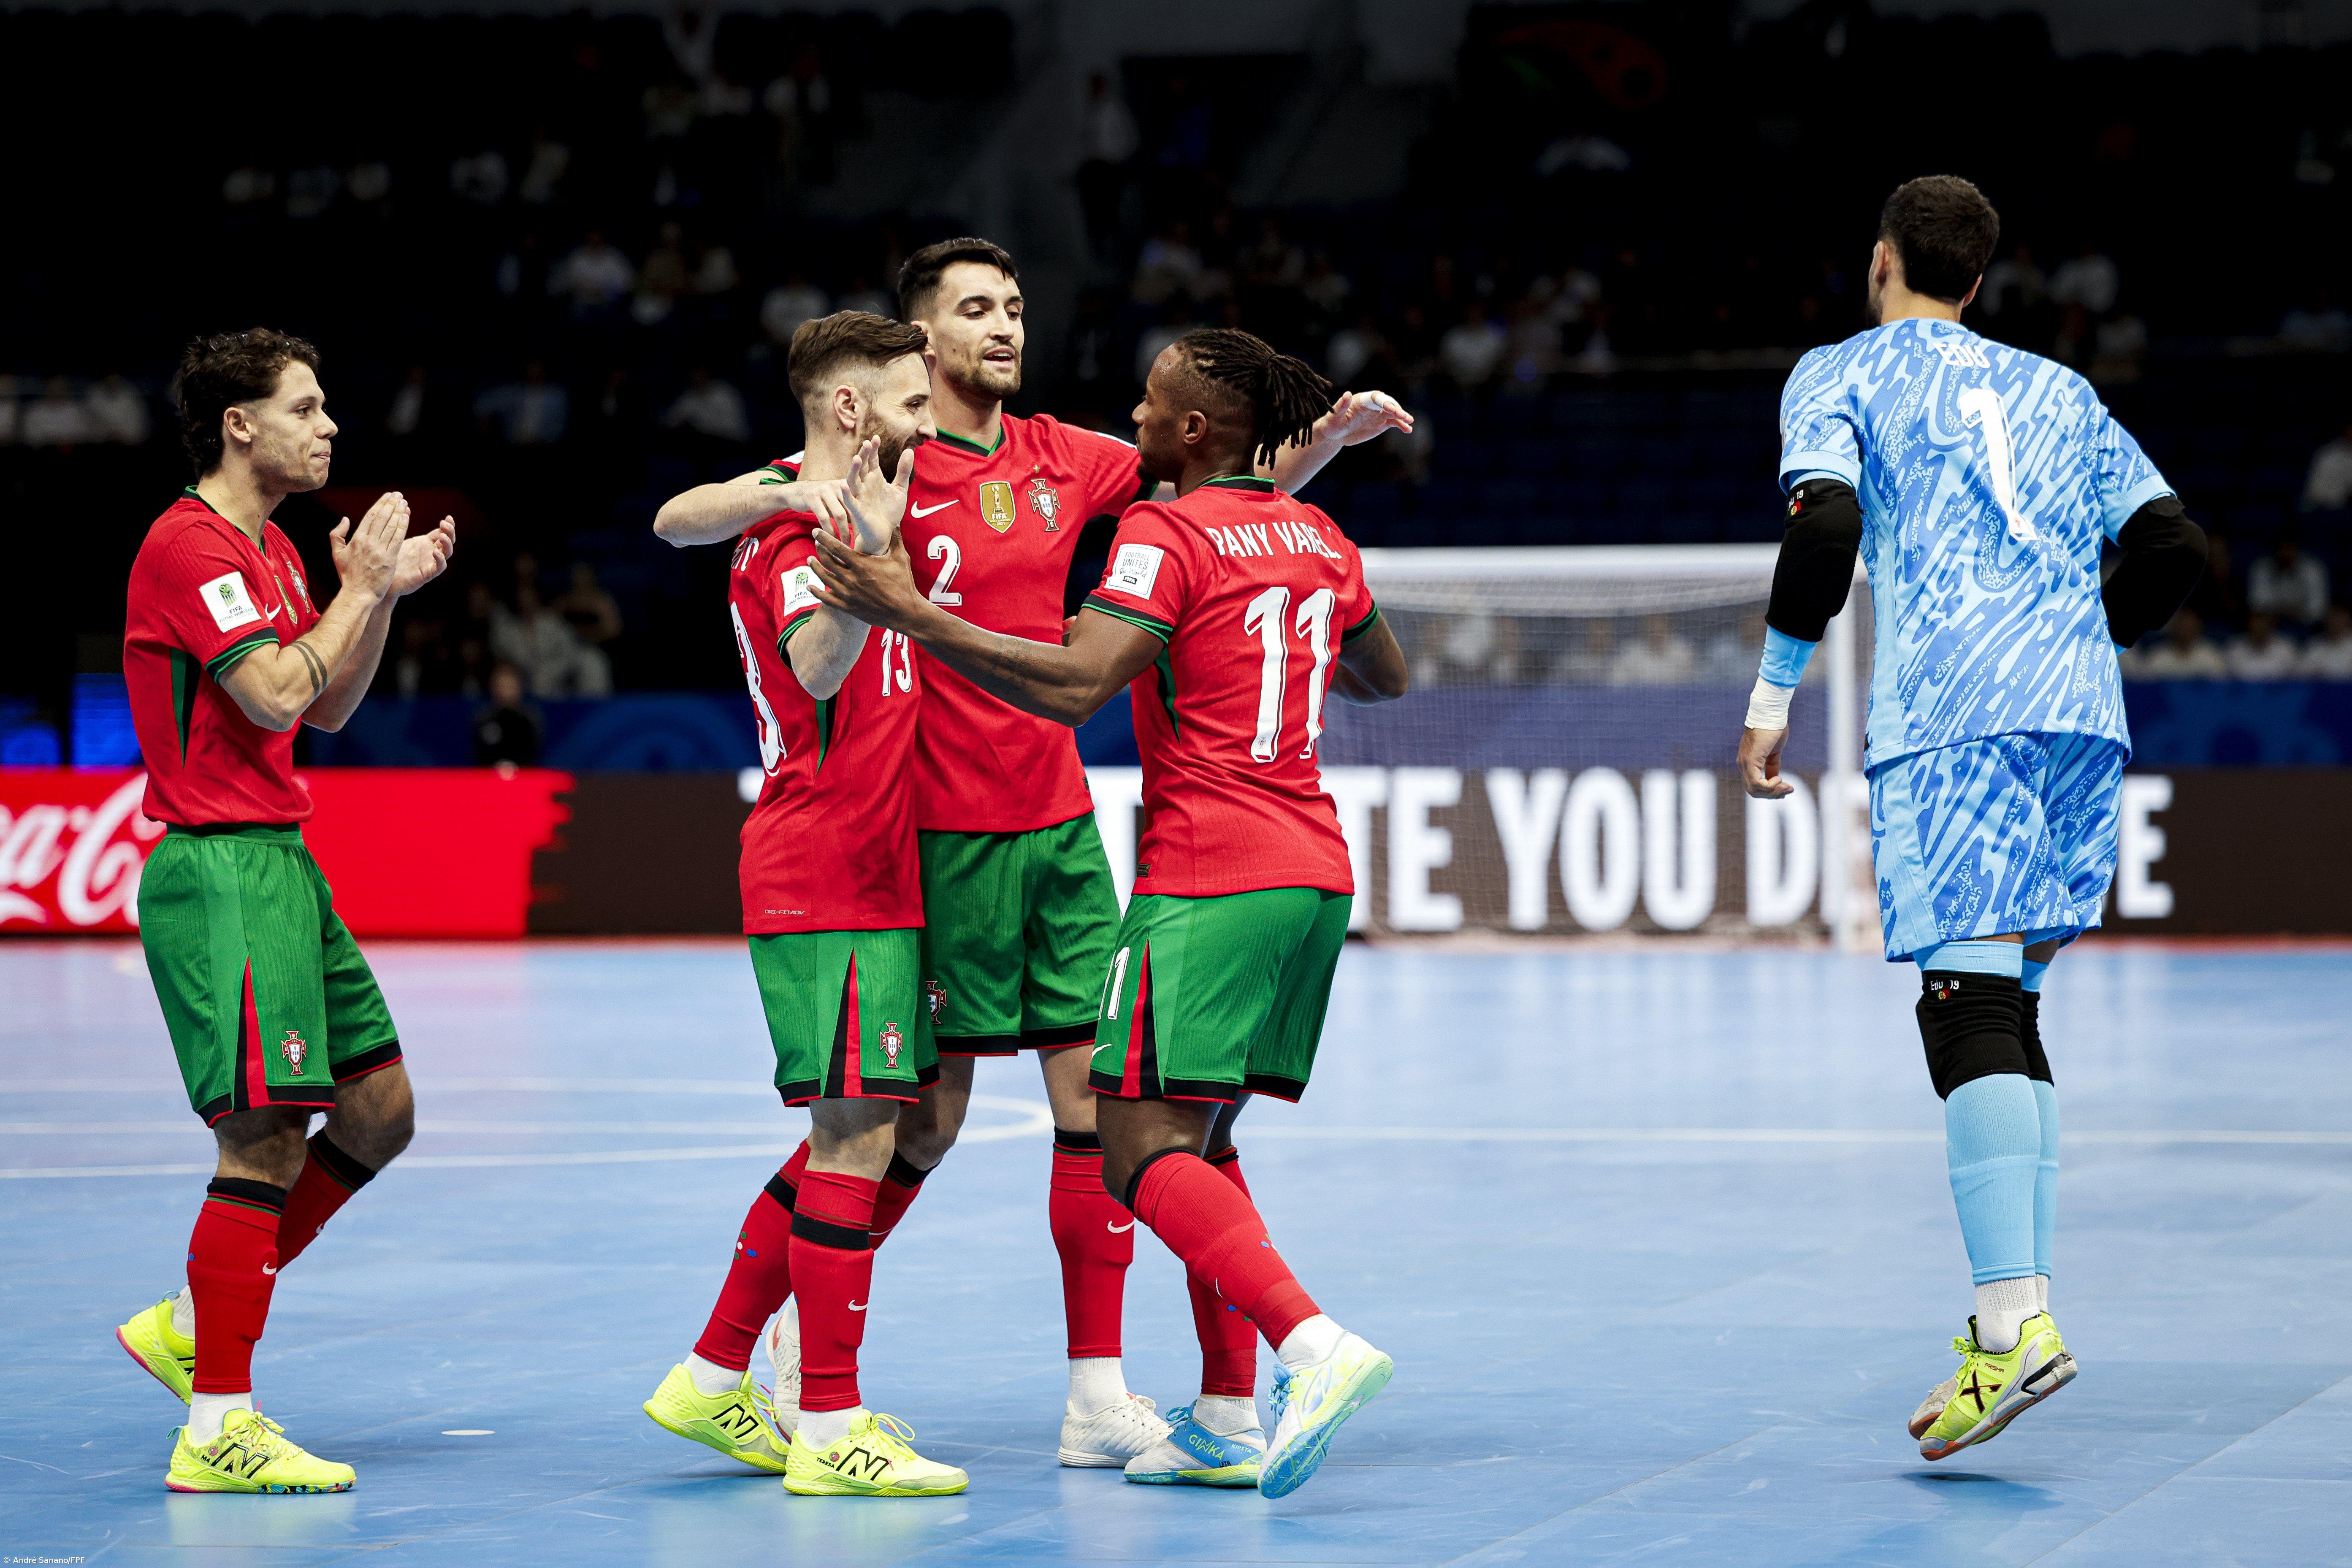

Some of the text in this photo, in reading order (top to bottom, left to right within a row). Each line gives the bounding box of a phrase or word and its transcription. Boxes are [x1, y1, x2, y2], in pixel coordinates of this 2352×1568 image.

[1932, 343, 1991, 368] EDU
[1959, 388, 2038, 541] 1
[1797, 489, 1804, 500] 19
[1204, 523, 1274, 557] PANY
[1125, 552, 1149, 561] FOOTBALL
[1122, 558, 1148, 569] UNITES
[927, 534, 962, 606] 2
[1128, 568, 1147, 579] World
[229, 605, 242, 614] FIFA
[219, 614, 233, 623] FUTSAL
[881, 628, 912, 697] 13
[1244, 586, 1336, 763] 11
[1484, 765, 1718, 931] YOU
[1930, 979, 1943, 991] Edu
[1984, 1362, 2004, 1373] PRISMA
[1231, 1443, 1252, 1454] KIPSTA
[817, 1457, 835, 1468] TERESA
